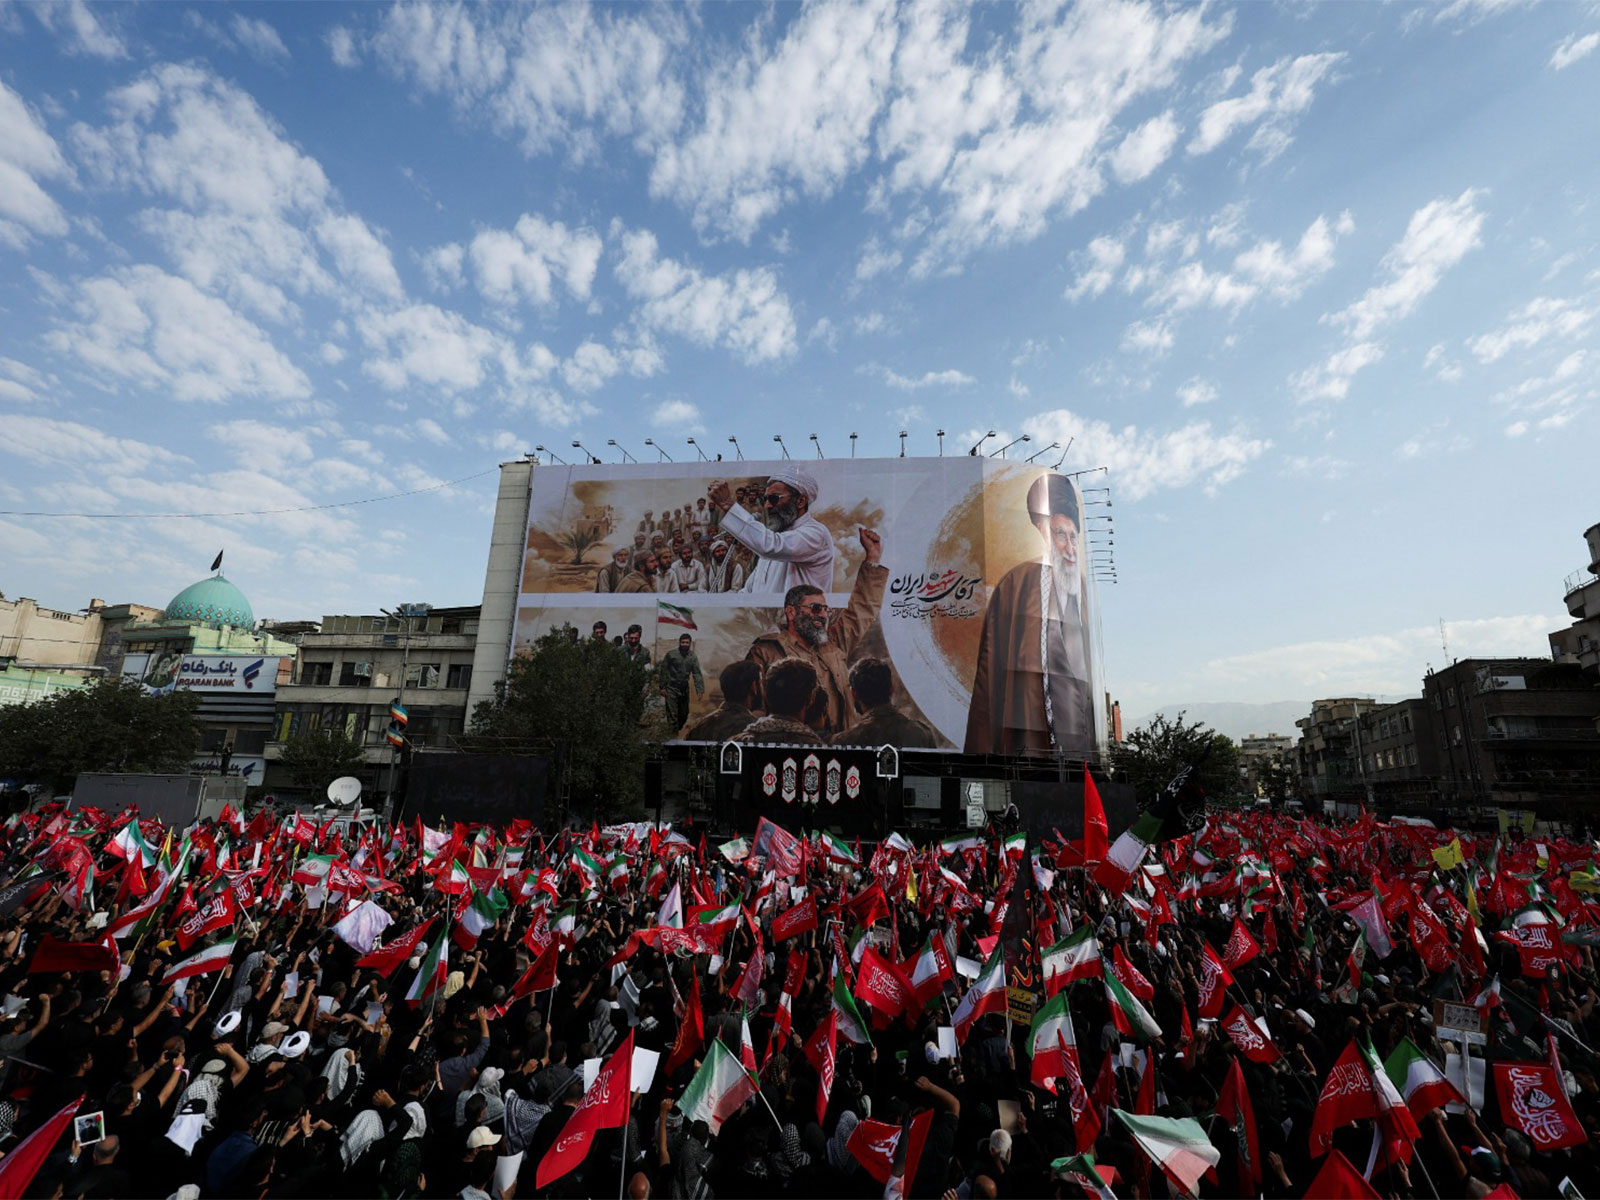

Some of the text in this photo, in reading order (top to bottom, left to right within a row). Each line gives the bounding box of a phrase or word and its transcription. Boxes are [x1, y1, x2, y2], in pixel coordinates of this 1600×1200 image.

[890, 572, 925, 601] ایران
[917, 569, 958, 597] شهید
[181, 659, 237, 677] بانک رفاه
[212, 679, 236, 687] BANK
